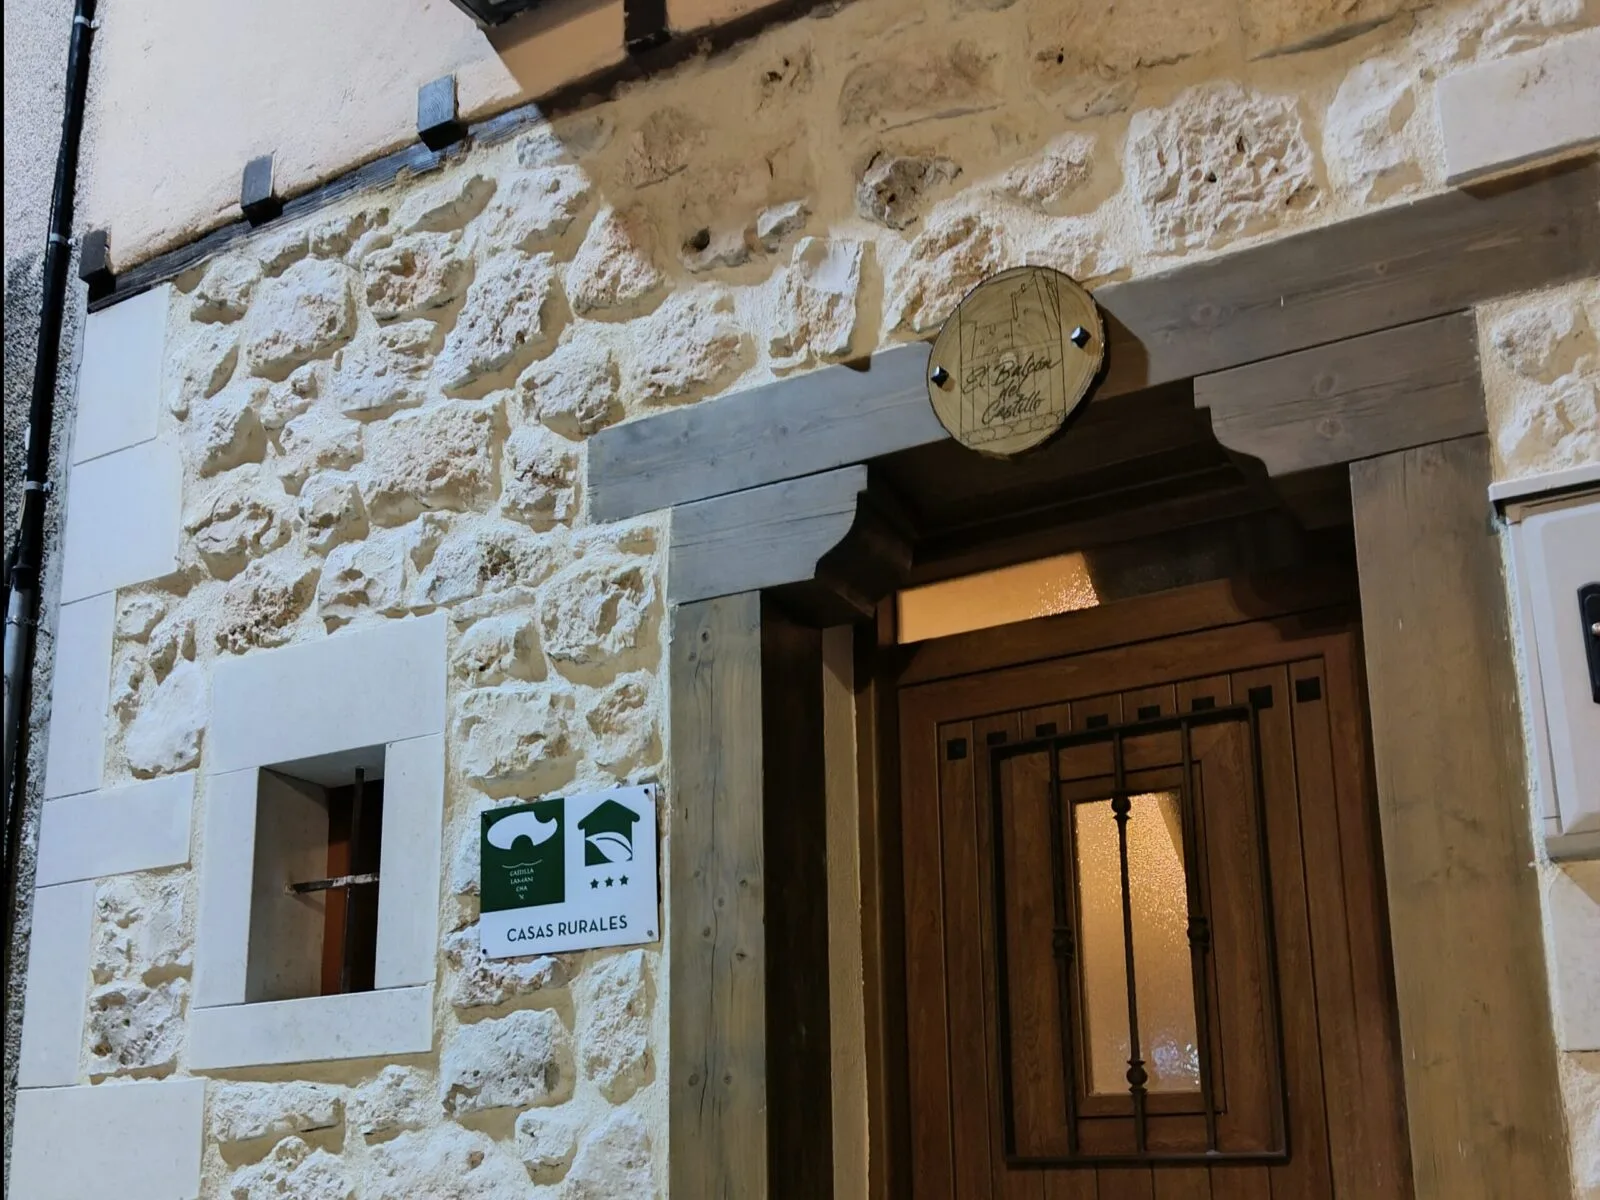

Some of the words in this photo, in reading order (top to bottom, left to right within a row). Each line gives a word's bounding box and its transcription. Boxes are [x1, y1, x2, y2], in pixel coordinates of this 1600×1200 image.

[990, 353, 1063, 387] Balcón
[998, 378, 1023, 402] del
[981, 391, 1045, 425] Castillo
[507, 924, 554, 942] CASAS
[558, 915, 629, 937] RURALES
